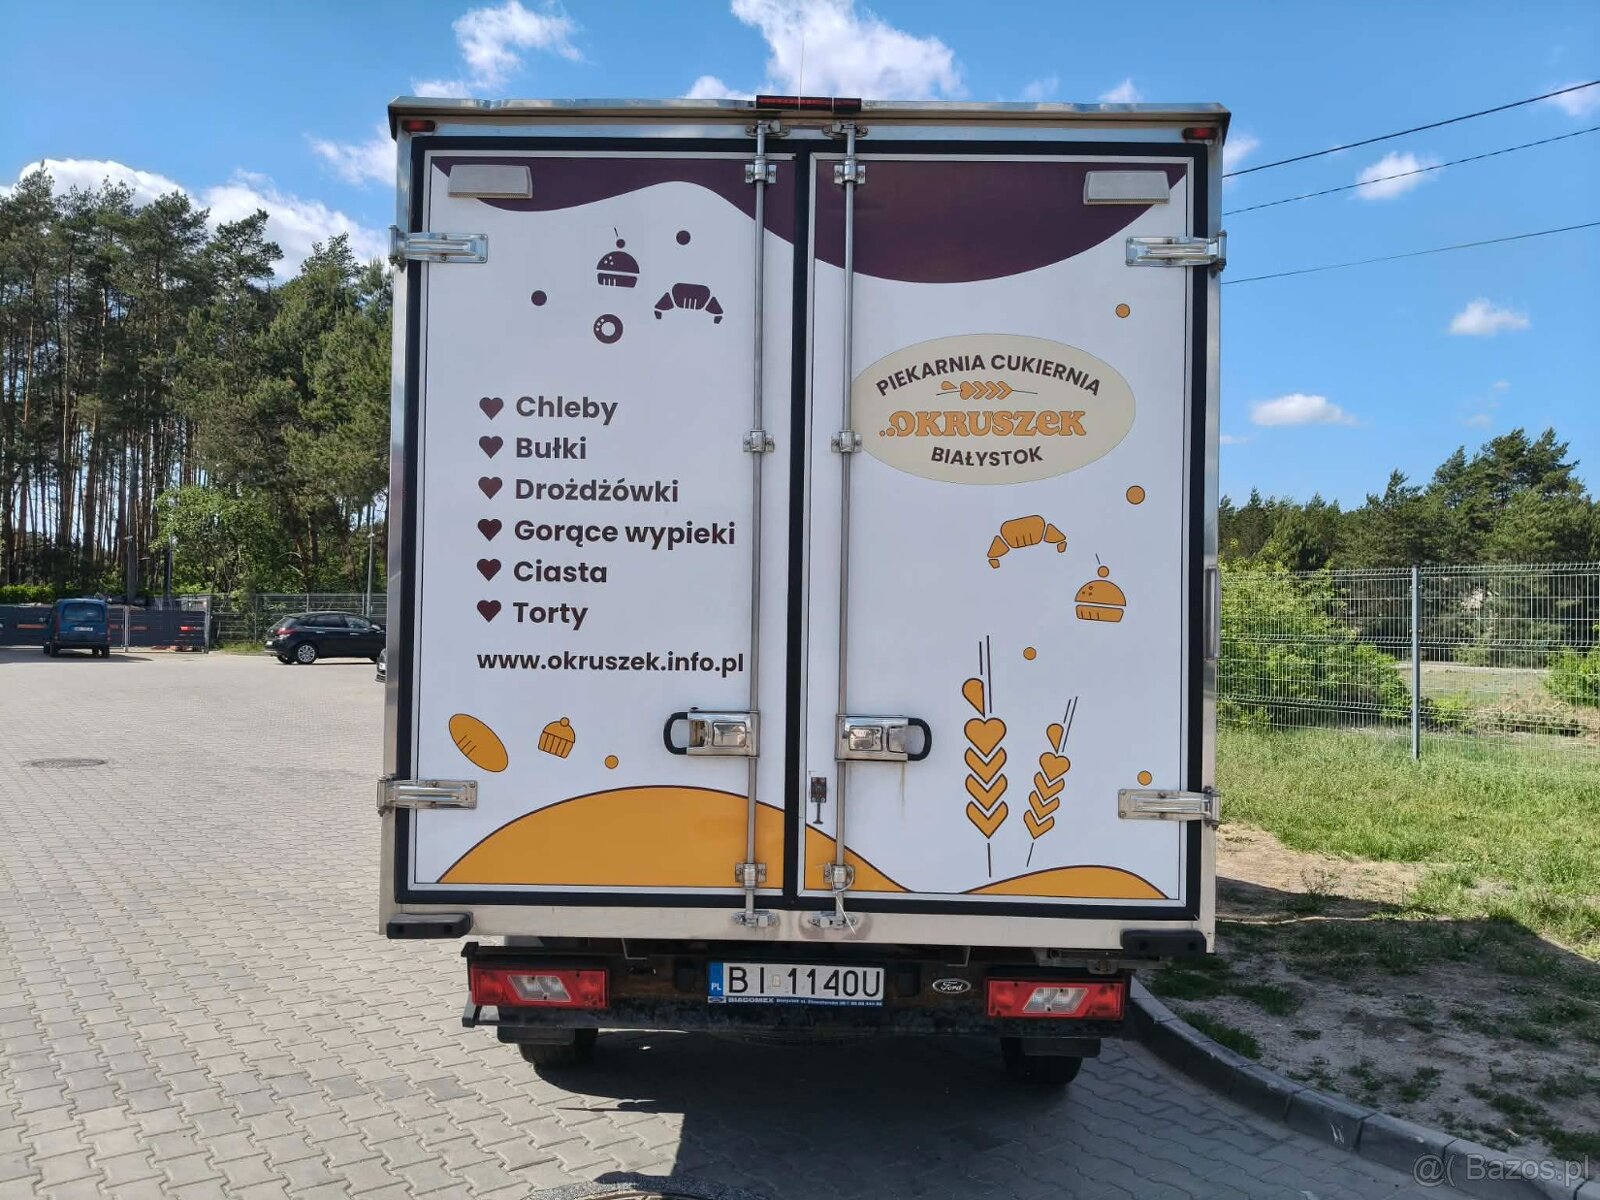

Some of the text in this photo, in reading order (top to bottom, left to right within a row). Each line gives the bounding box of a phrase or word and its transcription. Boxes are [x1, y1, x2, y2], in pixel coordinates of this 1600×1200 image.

[876, 354, 1101, 396] PIEKARNIA CUKIERNIA
[516, 396, 618, 425] Chleby
[516, 436, 587, 459] Bułki
[931, 446, 1043, 466] BIAŁYSTOK
[515, 478, 679, 502] Drożdżówki
[514, 520, 735, 550] Gorące wypieki
[513, 559, 607, 582] Ciasta
[513, 602, 588, 630] Torty
[477, 651, 744, 678] www.okruszek.info.pl
[711, 982, 722, 991] PL
